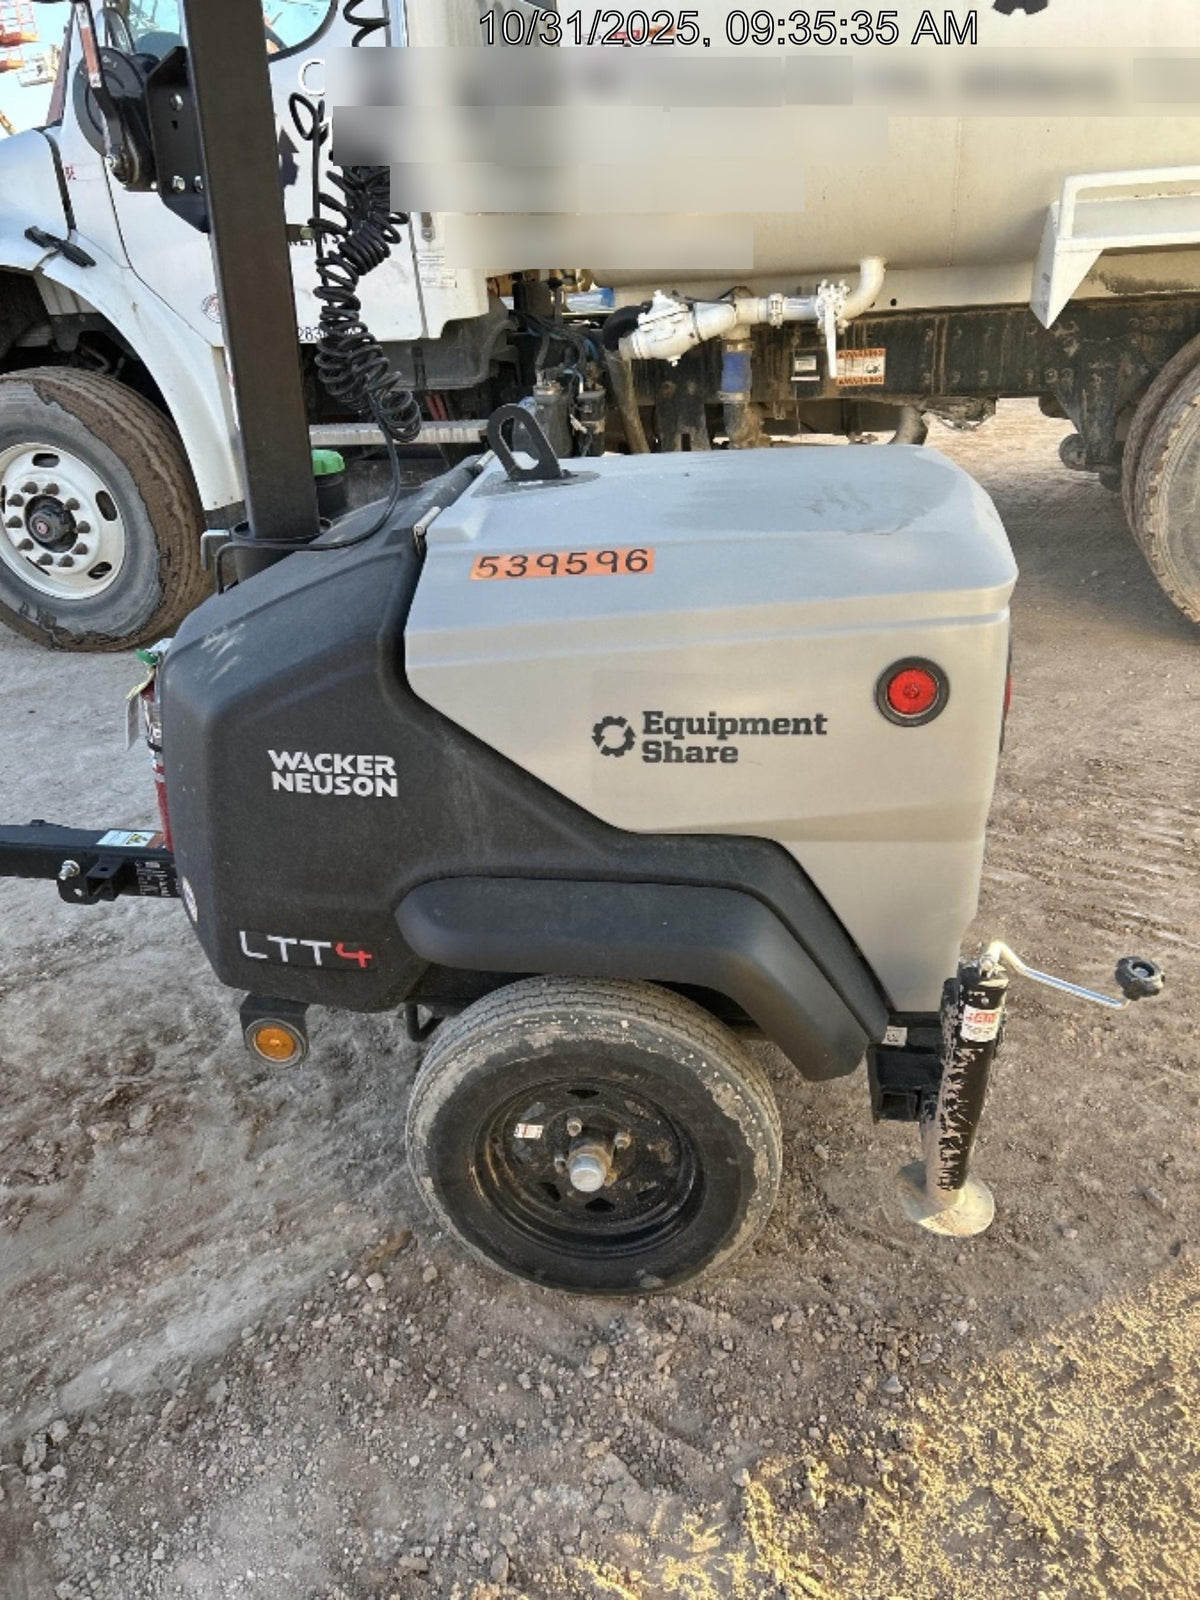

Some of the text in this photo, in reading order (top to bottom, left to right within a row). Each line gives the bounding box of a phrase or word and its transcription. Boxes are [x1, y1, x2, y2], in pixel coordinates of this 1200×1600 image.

[475, 549, 648, 578] 539596
[641, 711, 828, 740] Equipment
[267, 749, 397, 776] WACKER
[641, 740, 739, 763] Share
[271, 771, 398, 797] NEUSON
[239, 931, 372, 968] LTT4
